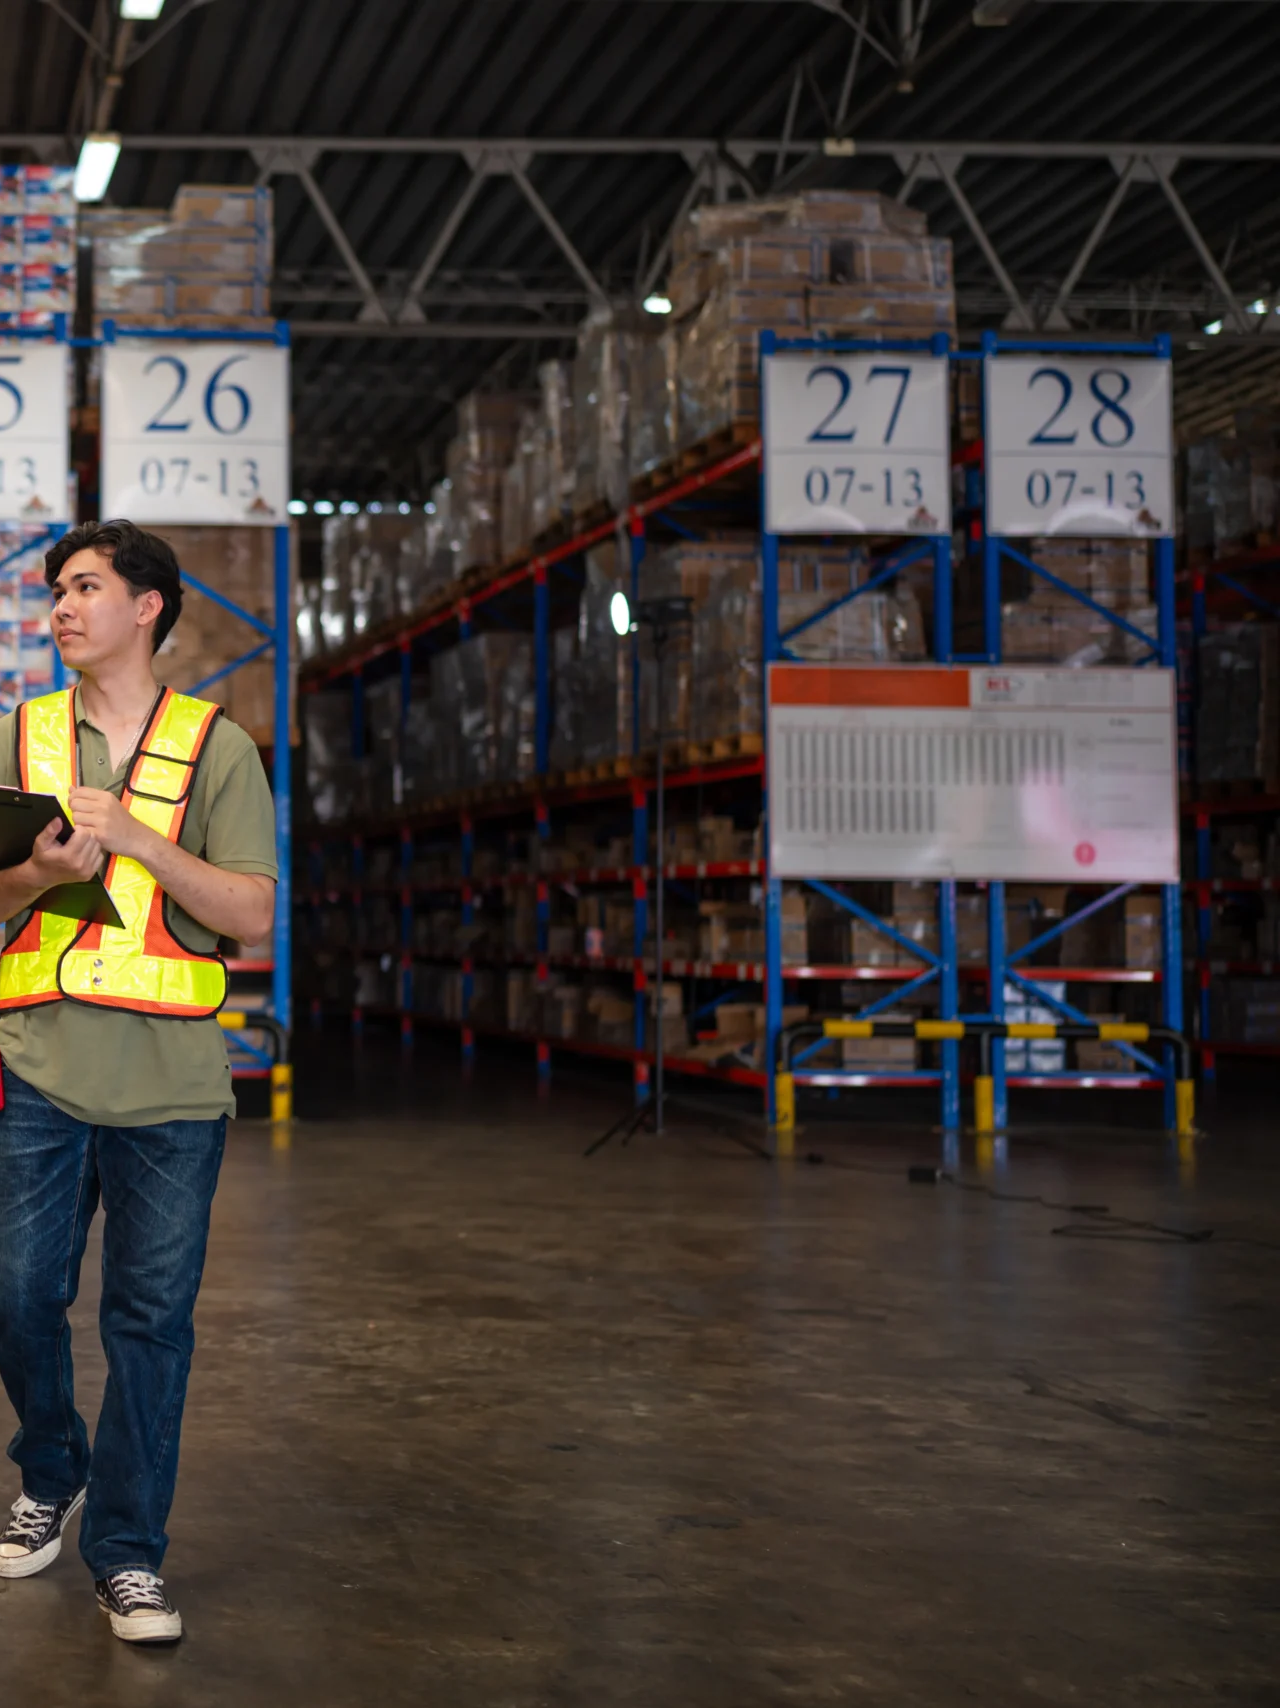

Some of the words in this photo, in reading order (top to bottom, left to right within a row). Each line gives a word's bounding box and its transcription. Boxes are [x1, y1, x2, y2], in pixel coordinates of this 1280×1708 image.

[143, 354, 252, 435] 26
[806, 365, 911, 446] 27
[1028, 367, 1135, 447] 28
[141, 458, 260, 498] 07-13
[805, 467, 923, 507] 07-13
[1026, 470, 1146, 510] 07-13
